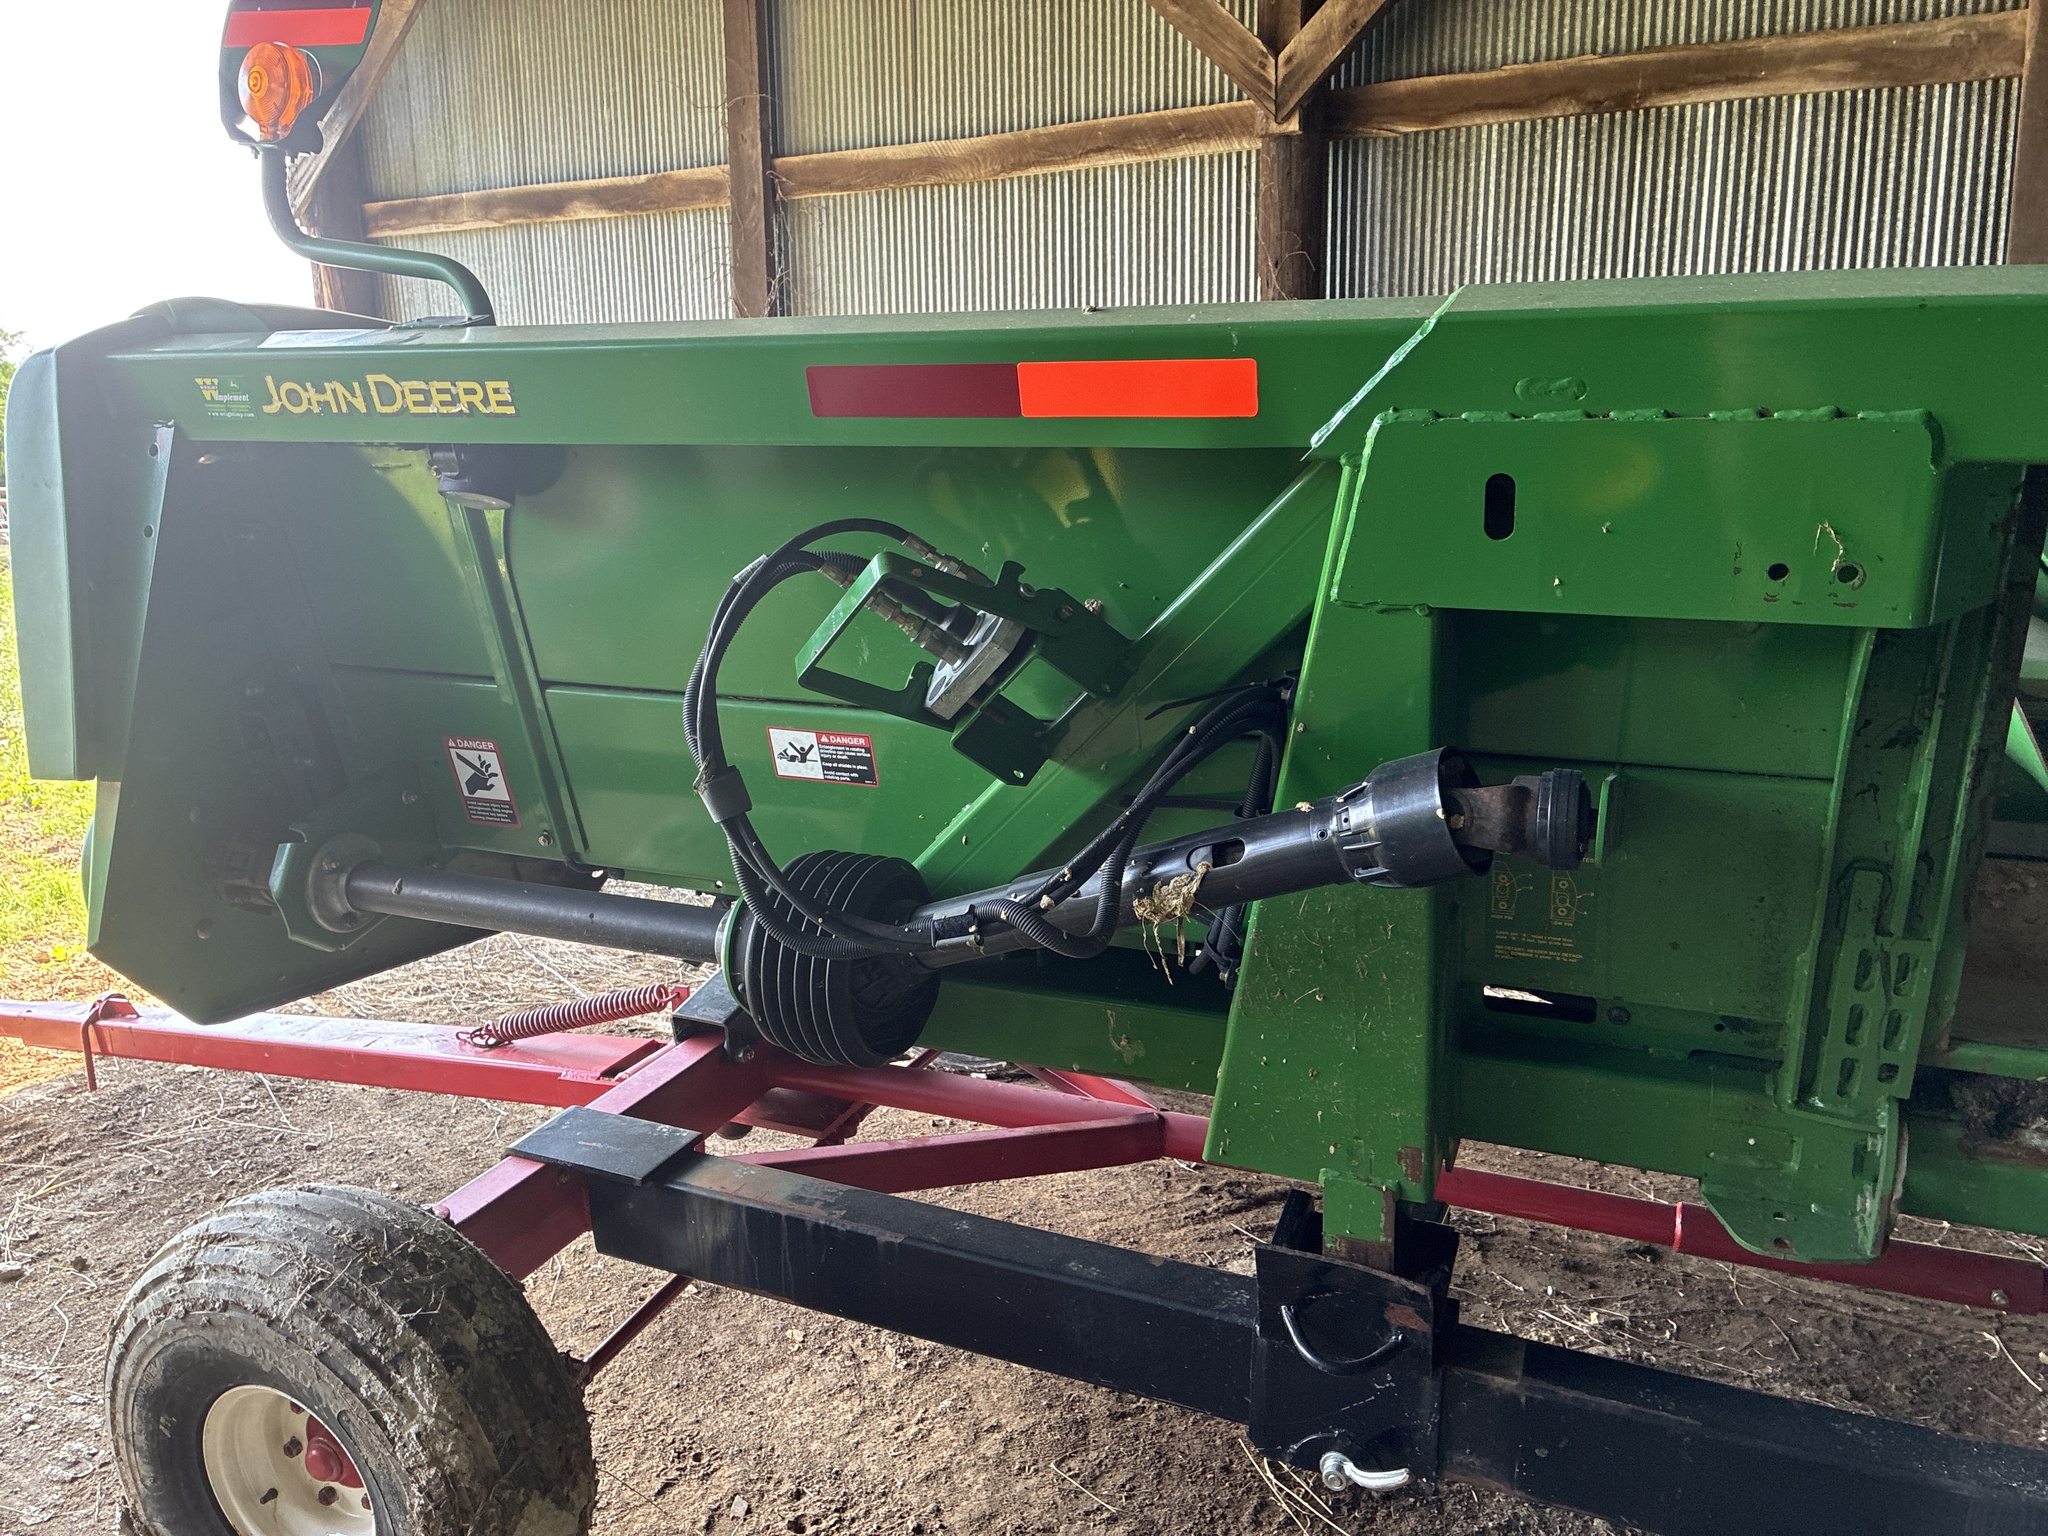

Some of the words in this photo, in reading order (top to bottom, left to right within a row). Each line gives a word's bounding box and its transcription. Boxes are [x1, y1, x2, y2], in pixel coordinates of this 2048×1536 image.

[262, 374, 367, 414] JOHN
[366, 374, 516, 414] DEERE
[456, 739, 494, 750] DANGER
[830, 736, 866, 746] DANGER
